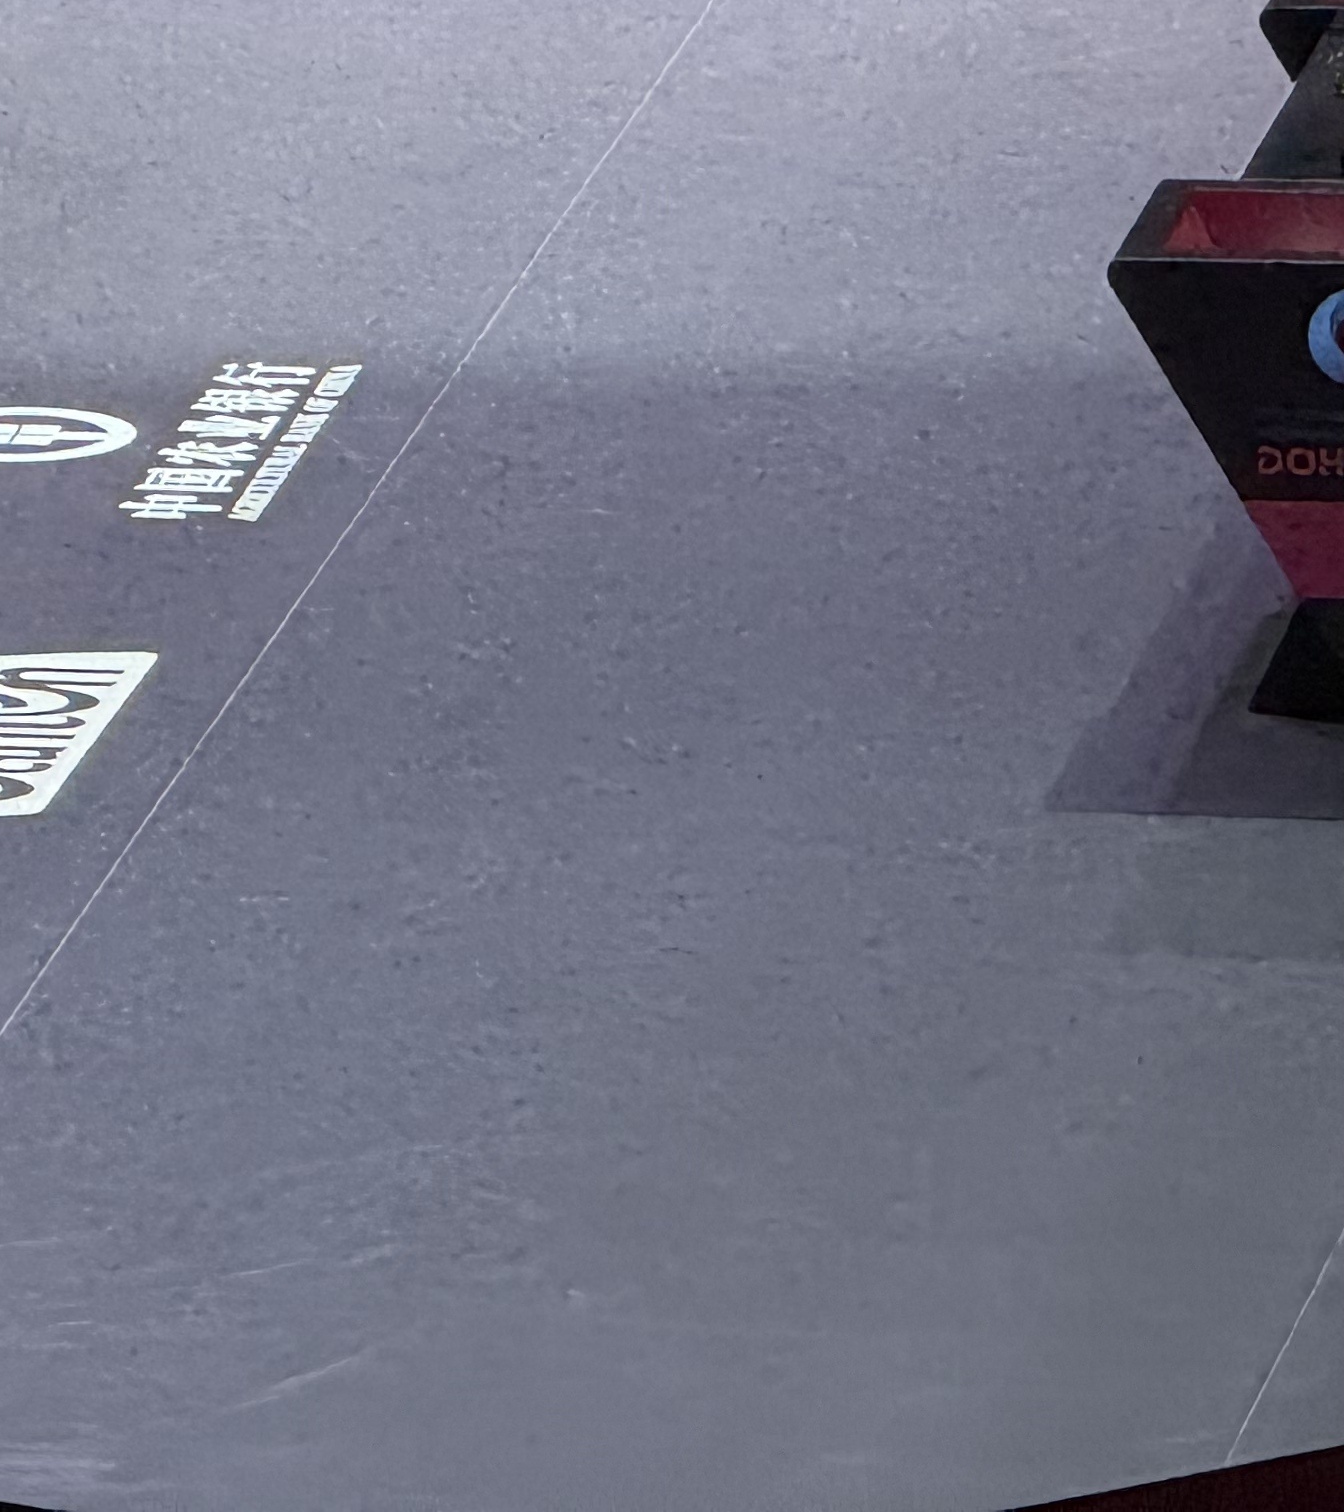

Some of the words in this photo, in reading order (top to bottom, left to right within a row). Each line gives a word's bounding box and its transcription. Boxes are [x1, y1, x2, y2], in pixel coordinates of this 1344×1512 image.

[117, 361, 317, 520] 中国农业银行
